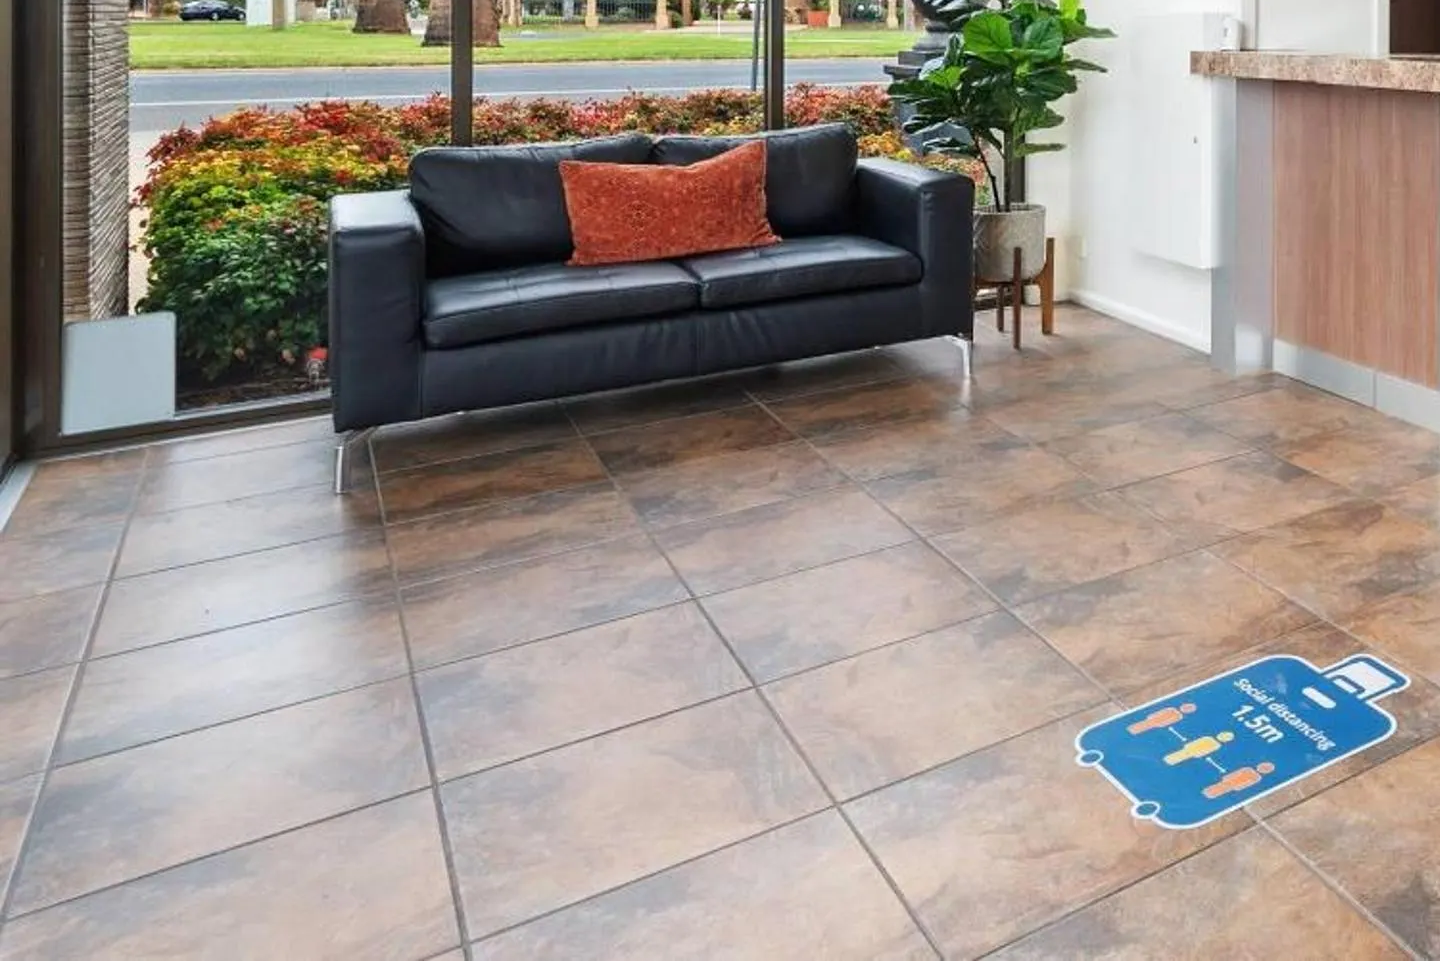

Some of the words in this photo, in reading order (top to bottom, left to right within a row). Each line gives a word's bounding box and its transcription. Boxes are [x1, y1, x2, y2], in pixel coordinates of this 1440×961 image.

[1231, 705, 1285, 744] 1.5m
[1233, 678, 1276, 705] Social
[1267, 702, 1337, 751] distancing
